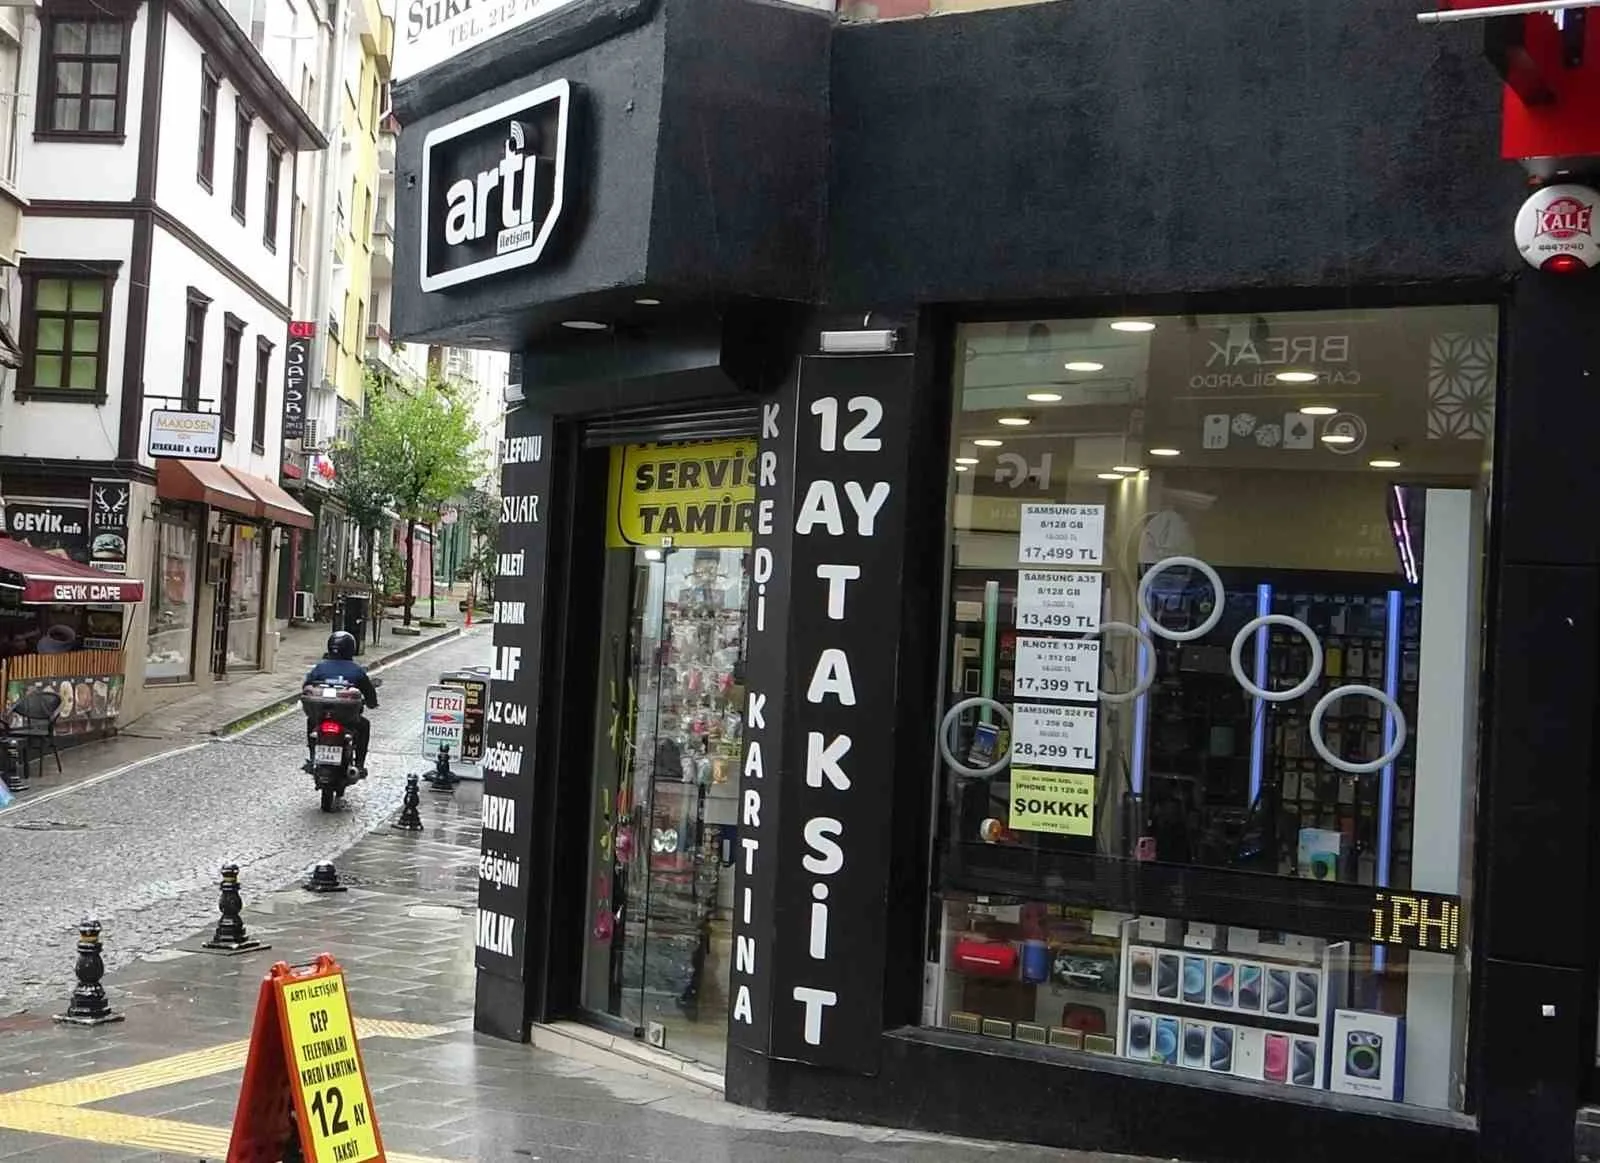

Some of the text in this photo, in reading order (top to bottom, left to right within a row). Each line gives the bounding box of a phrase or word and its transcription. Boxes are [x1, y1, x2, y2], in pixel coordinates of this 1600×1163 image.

[1537, 207, 1591, 235] KALE
[810, 396, 883, 451] 12
[501, 435, 542, 464] LEFONU
[499, 495, 539, 523] SUAR
[755, 403, 780, 631] KREDİ
[796, 480, 891, 536] AY
[1027, 506, 1077, 516] SAMSUNG
[13, 509, 81, 534] GEYİK cafe
[1069, 521, 1083, 529] GB
[1024, 547, 1097, 560] 17,499 TL
[1024, 573, 1096, 583] SAMSUNG A35
[90, 585, 121, 600] CAFE
[1066, 588, 1080, 596] GB
[501, 601, 525, 624] BANK
[1022, 614, 1095, 627] 13,499 TL
[1076, 642, 1098, 651] PRO
[1016, 677, 1094, 693] 17,399 TL
[504, 704, 527, 726] CAM
[1018, 706, 1062, 716] SAMSUNG
[427, 725, 460, 737] MURAT
[1014, 742, 1093, 759] 28,299 TL
[793, 564, 861, 1046] TAKSİT
[1014, 798, 1089, 818] ŞOKKK
[734, 693, 767, 1025] KARTINA
[310, 1009, 328, 1033] CEP
[302, 1035, 348, 1061] TELEFONLARI
[301, 1057, 358, 1087] KREDİ KARTINA
[311, 1086, 367, 1138] 12 AY
